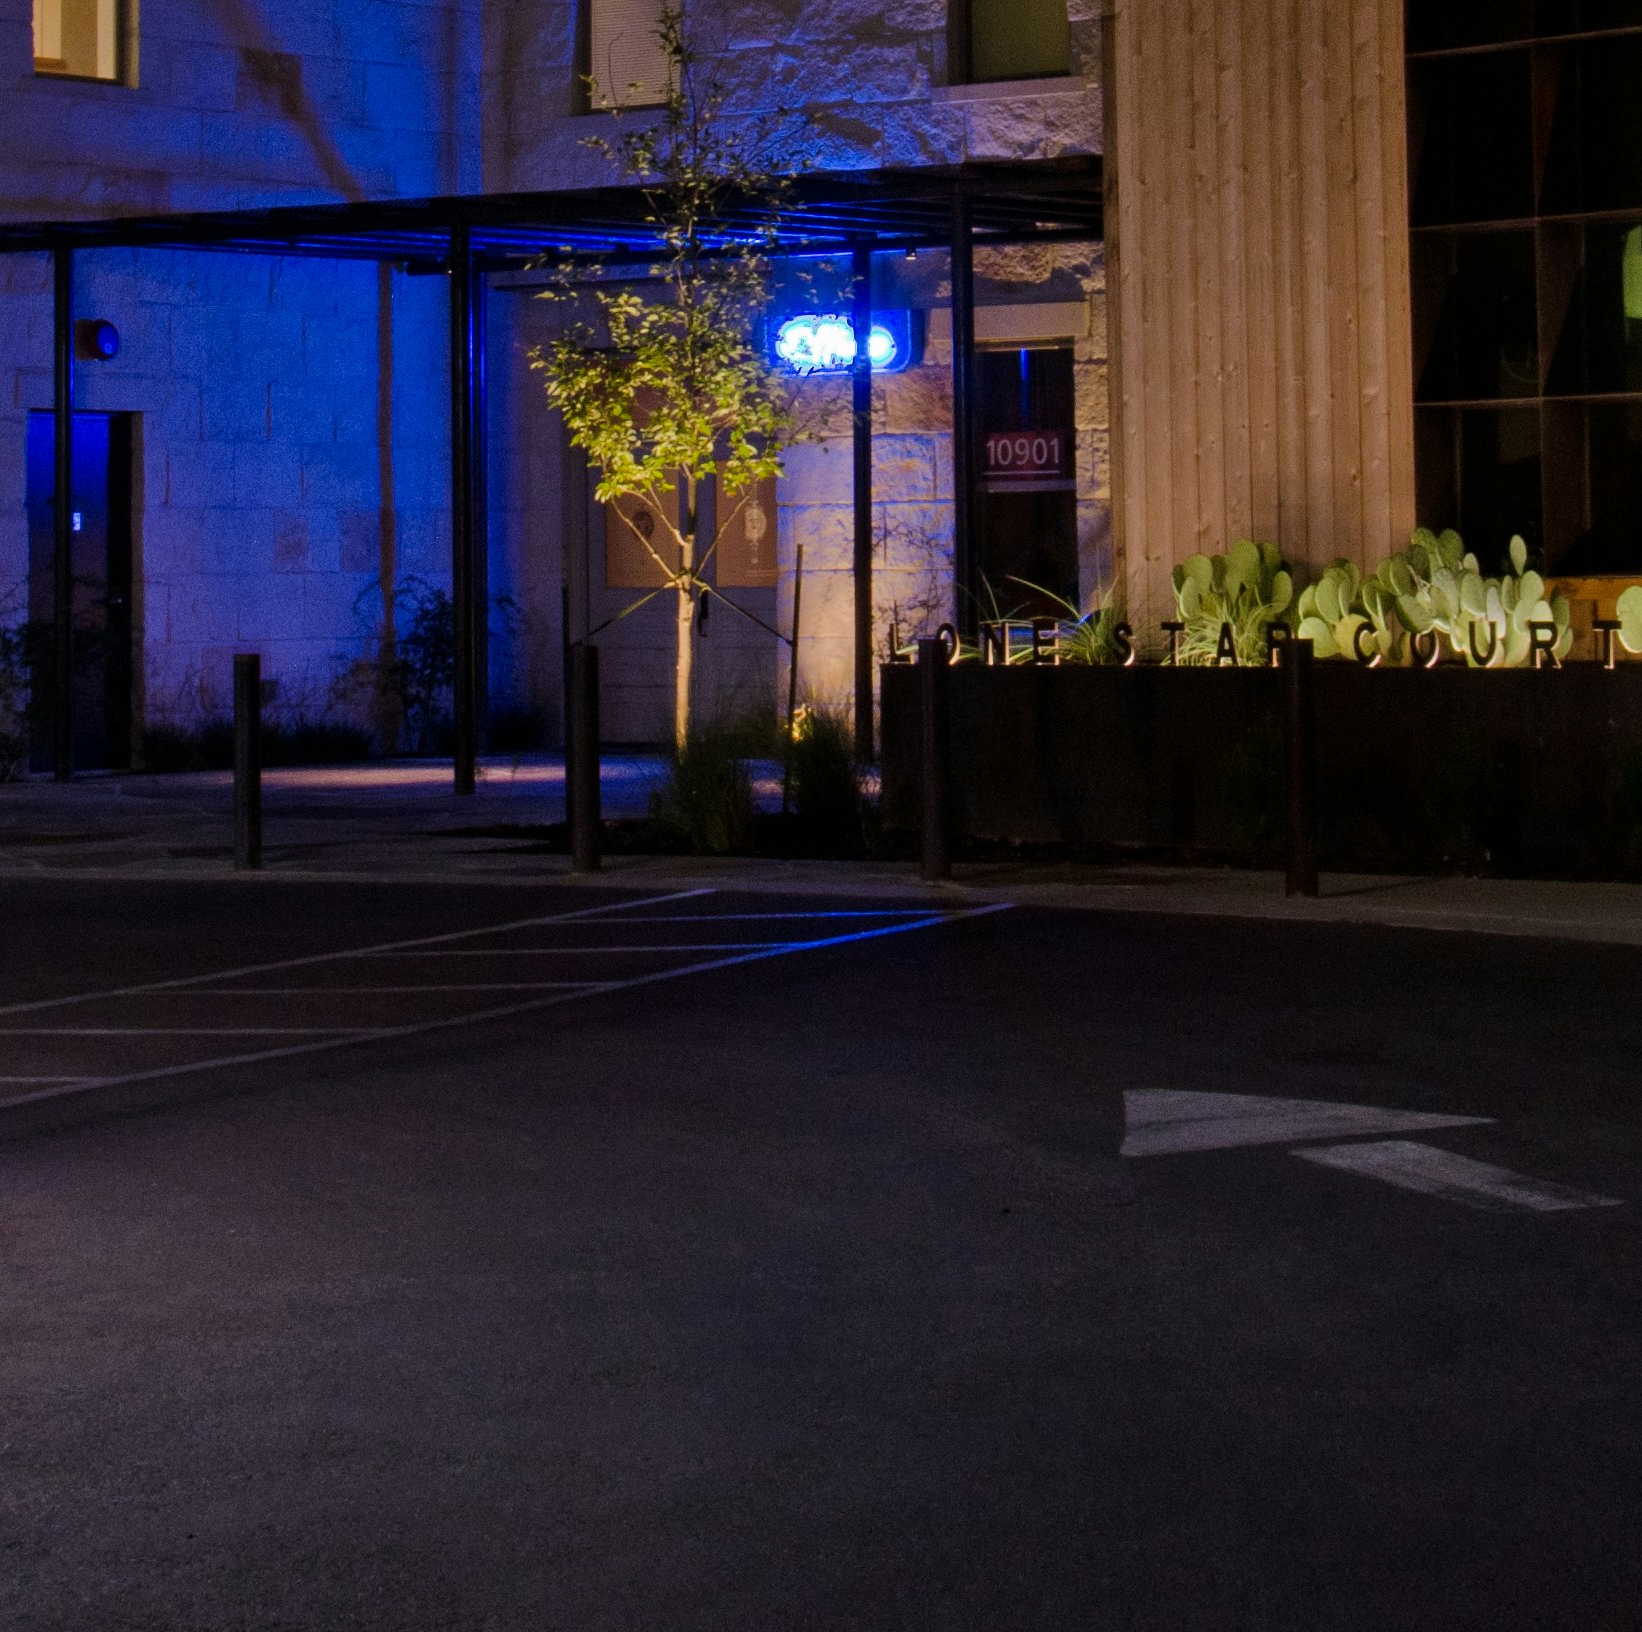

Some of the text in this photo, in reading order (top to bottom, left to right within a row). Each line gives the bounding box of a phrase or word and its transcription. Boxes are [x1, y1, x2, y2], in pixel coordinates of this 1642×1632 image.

[986, 438, 1060, 466] 10901
[888, 620, 1623, 669] LONE STAR COURT
